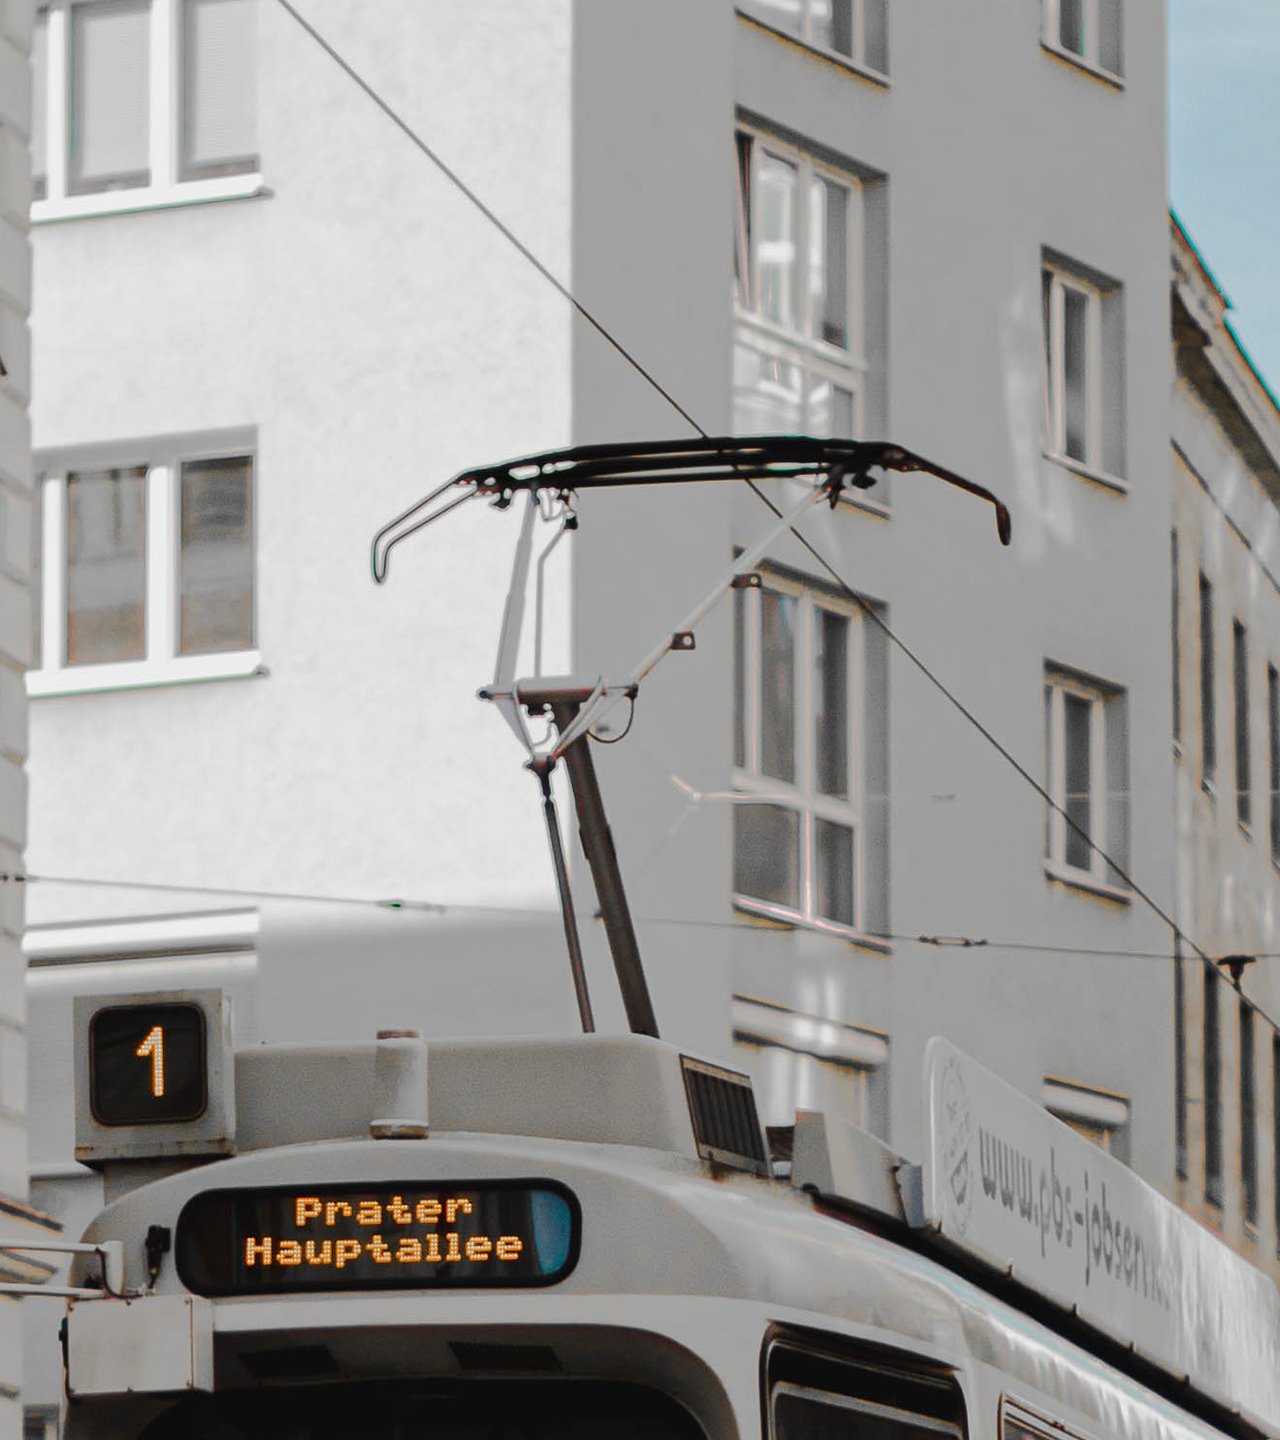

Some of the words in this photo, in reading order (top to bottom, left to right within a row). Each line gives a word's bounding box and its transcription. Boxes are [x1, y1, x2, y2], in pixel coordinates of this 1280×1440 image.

[136, 1026, 165, 1097] 1
[296, 1196, 472, 1226] Prater
[245, 1232, 523, 1268] Hauptallee
